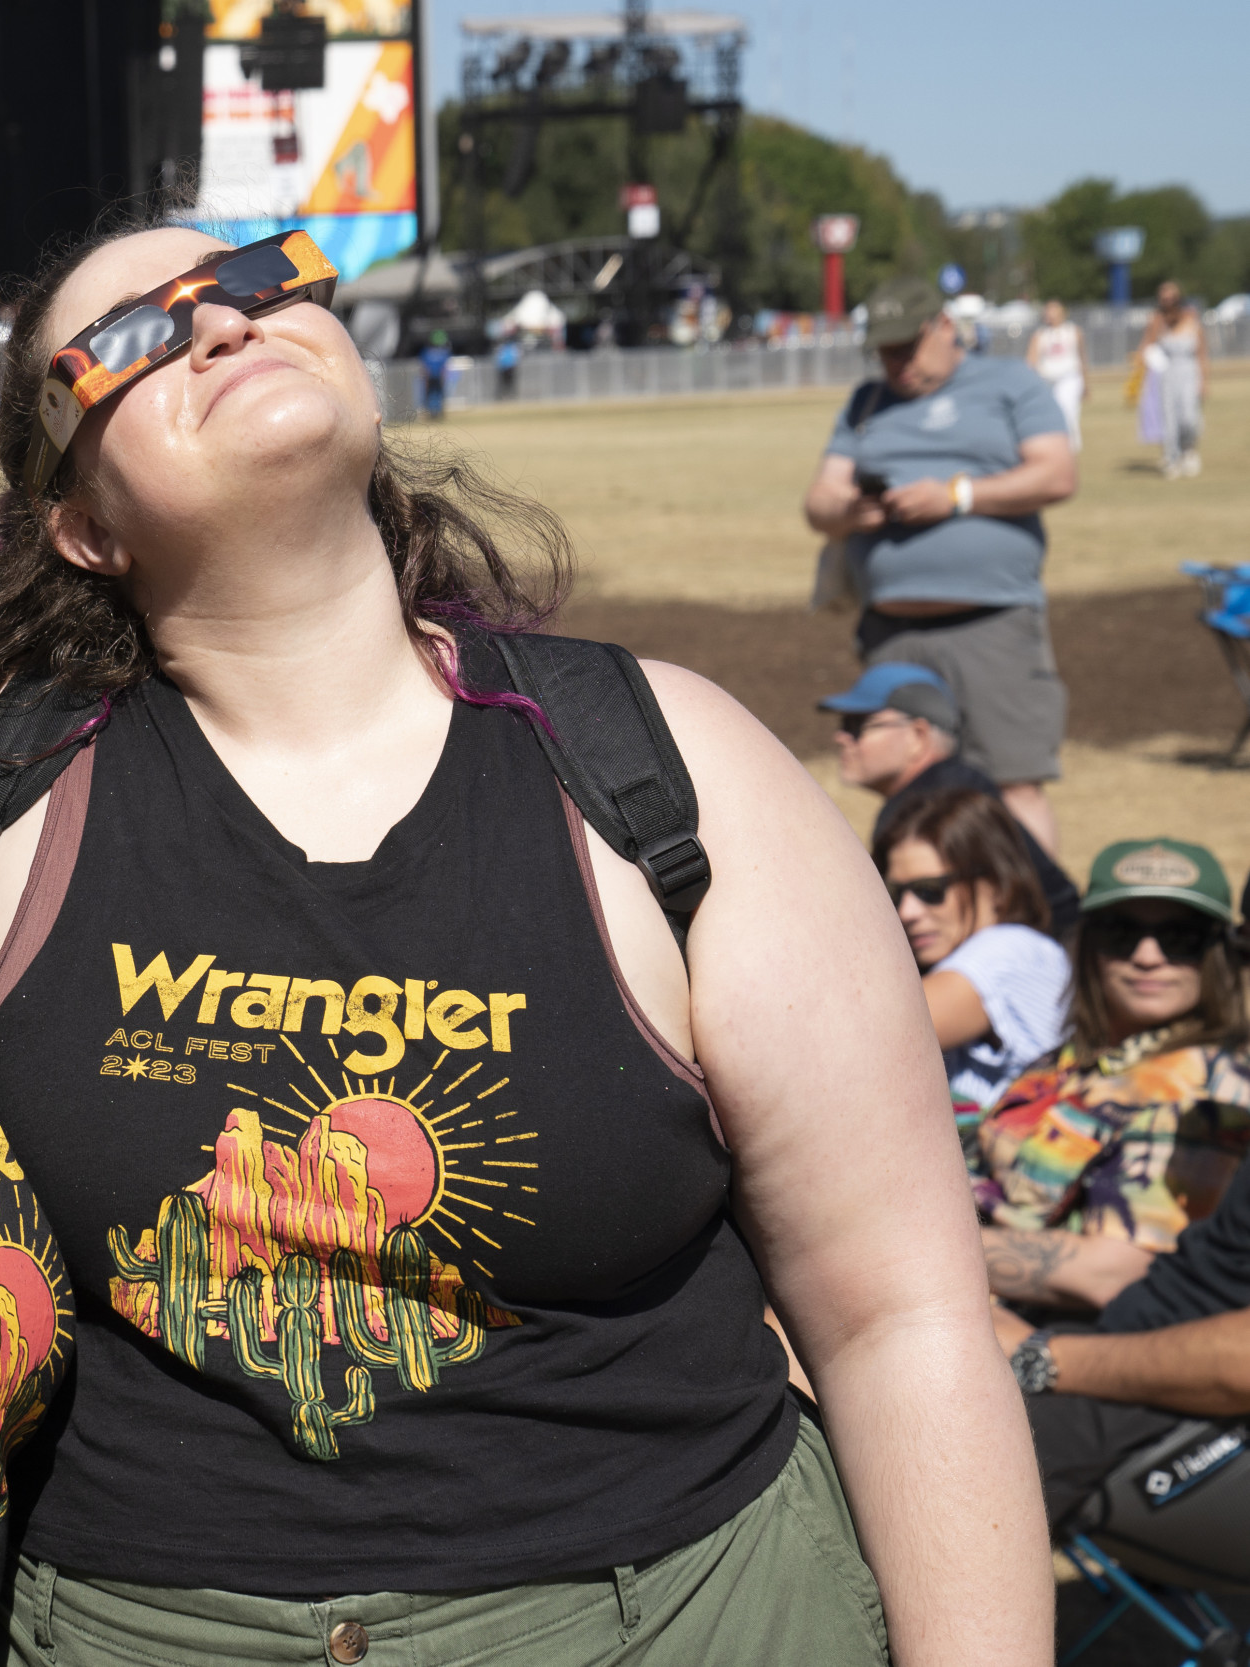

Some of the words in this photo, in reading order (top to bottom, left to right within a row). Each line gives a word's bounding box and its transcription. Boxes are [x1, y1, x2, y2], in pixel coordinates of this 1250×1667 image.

[104, 1027, 174, 1053] ACL
[184, 1036, 277, 1064] FEST
[111, 942, 527, 1075] Wrangler
